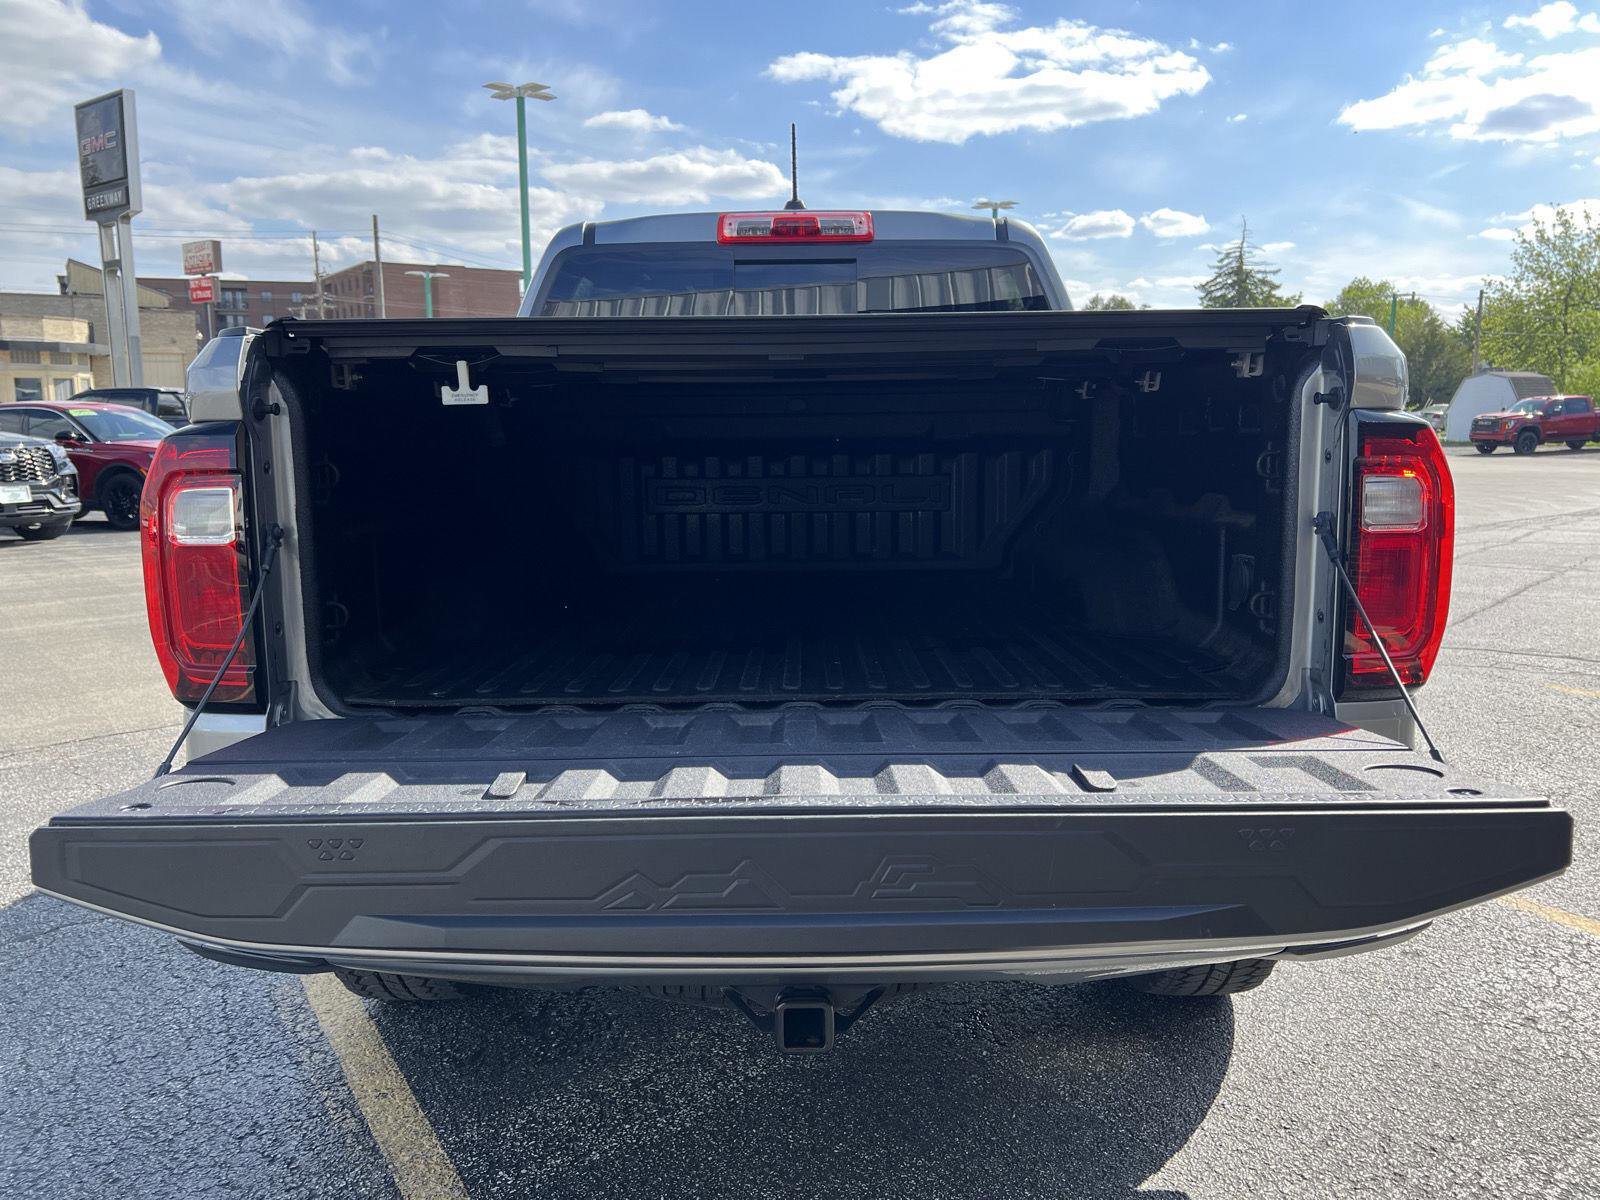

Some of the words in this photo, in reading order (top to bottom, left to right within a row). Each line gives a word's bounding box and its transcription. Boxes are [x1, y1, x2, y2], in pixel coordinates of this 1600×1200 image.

[80, 130, 117, 156] GMC
[87, 190, 122, 210] GREENWAY
[655, 483, 945, 506] DENALI
